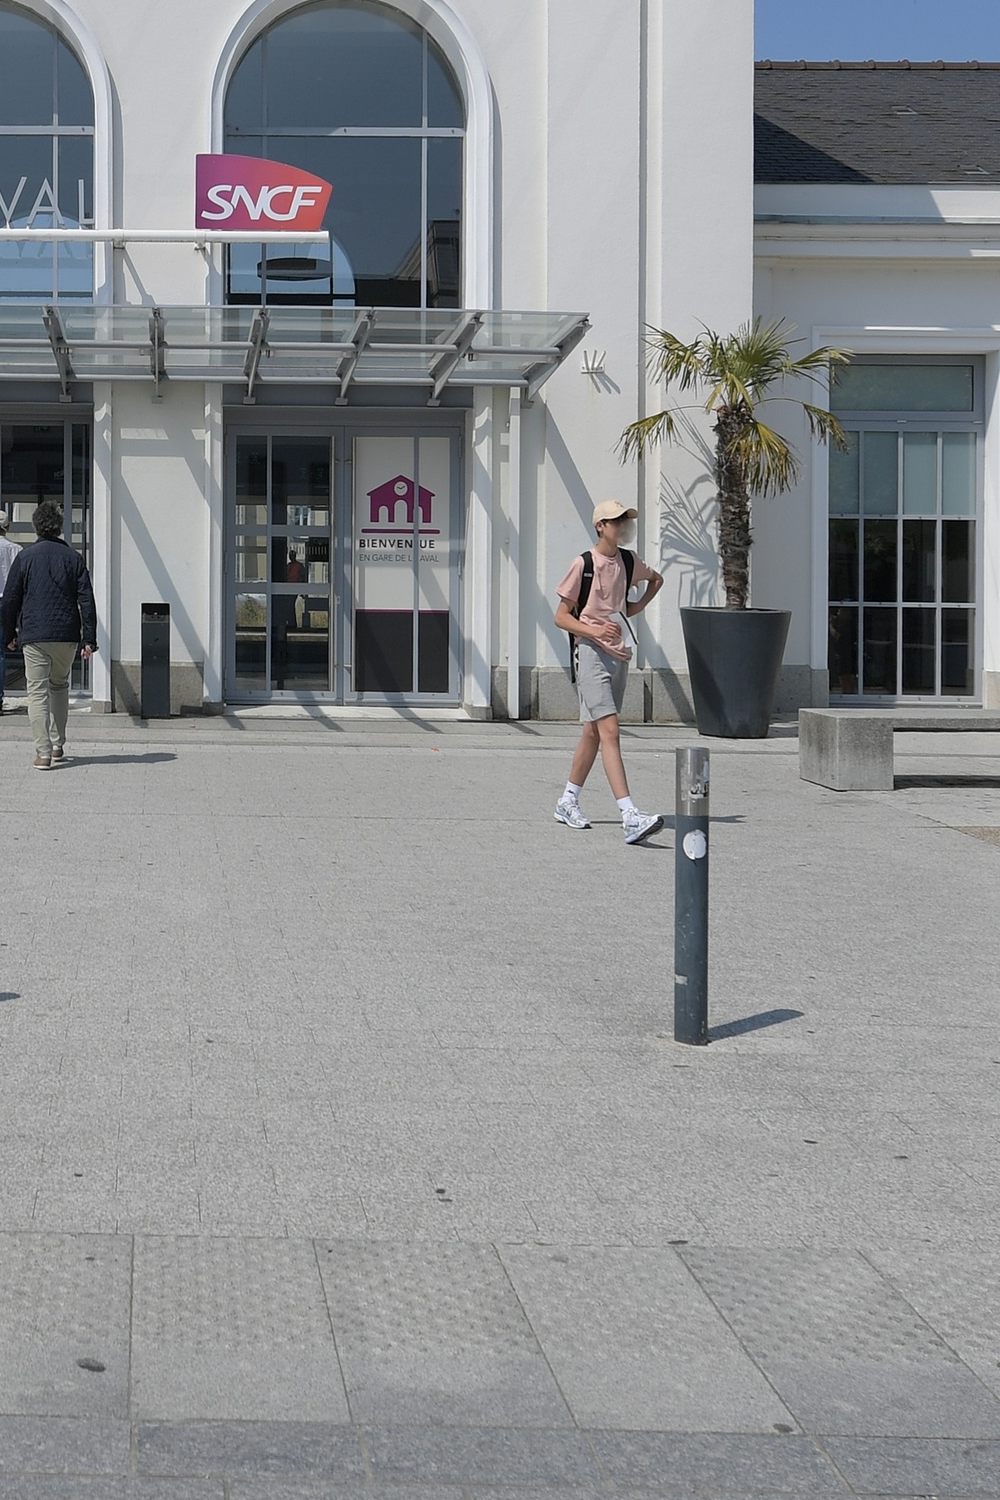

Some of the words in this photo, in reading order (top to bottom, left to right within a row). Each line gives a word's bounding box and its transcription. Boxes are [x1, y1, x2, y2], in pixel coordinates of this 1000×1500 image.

[200, 184, 323, 222] SNCF
[359, 539, 436, 549] BIENVENUE
[359, 553, 370, 561] EN
[371, 553, 394, 561] GARE
[407, 554, 440, 562] LAVAL
